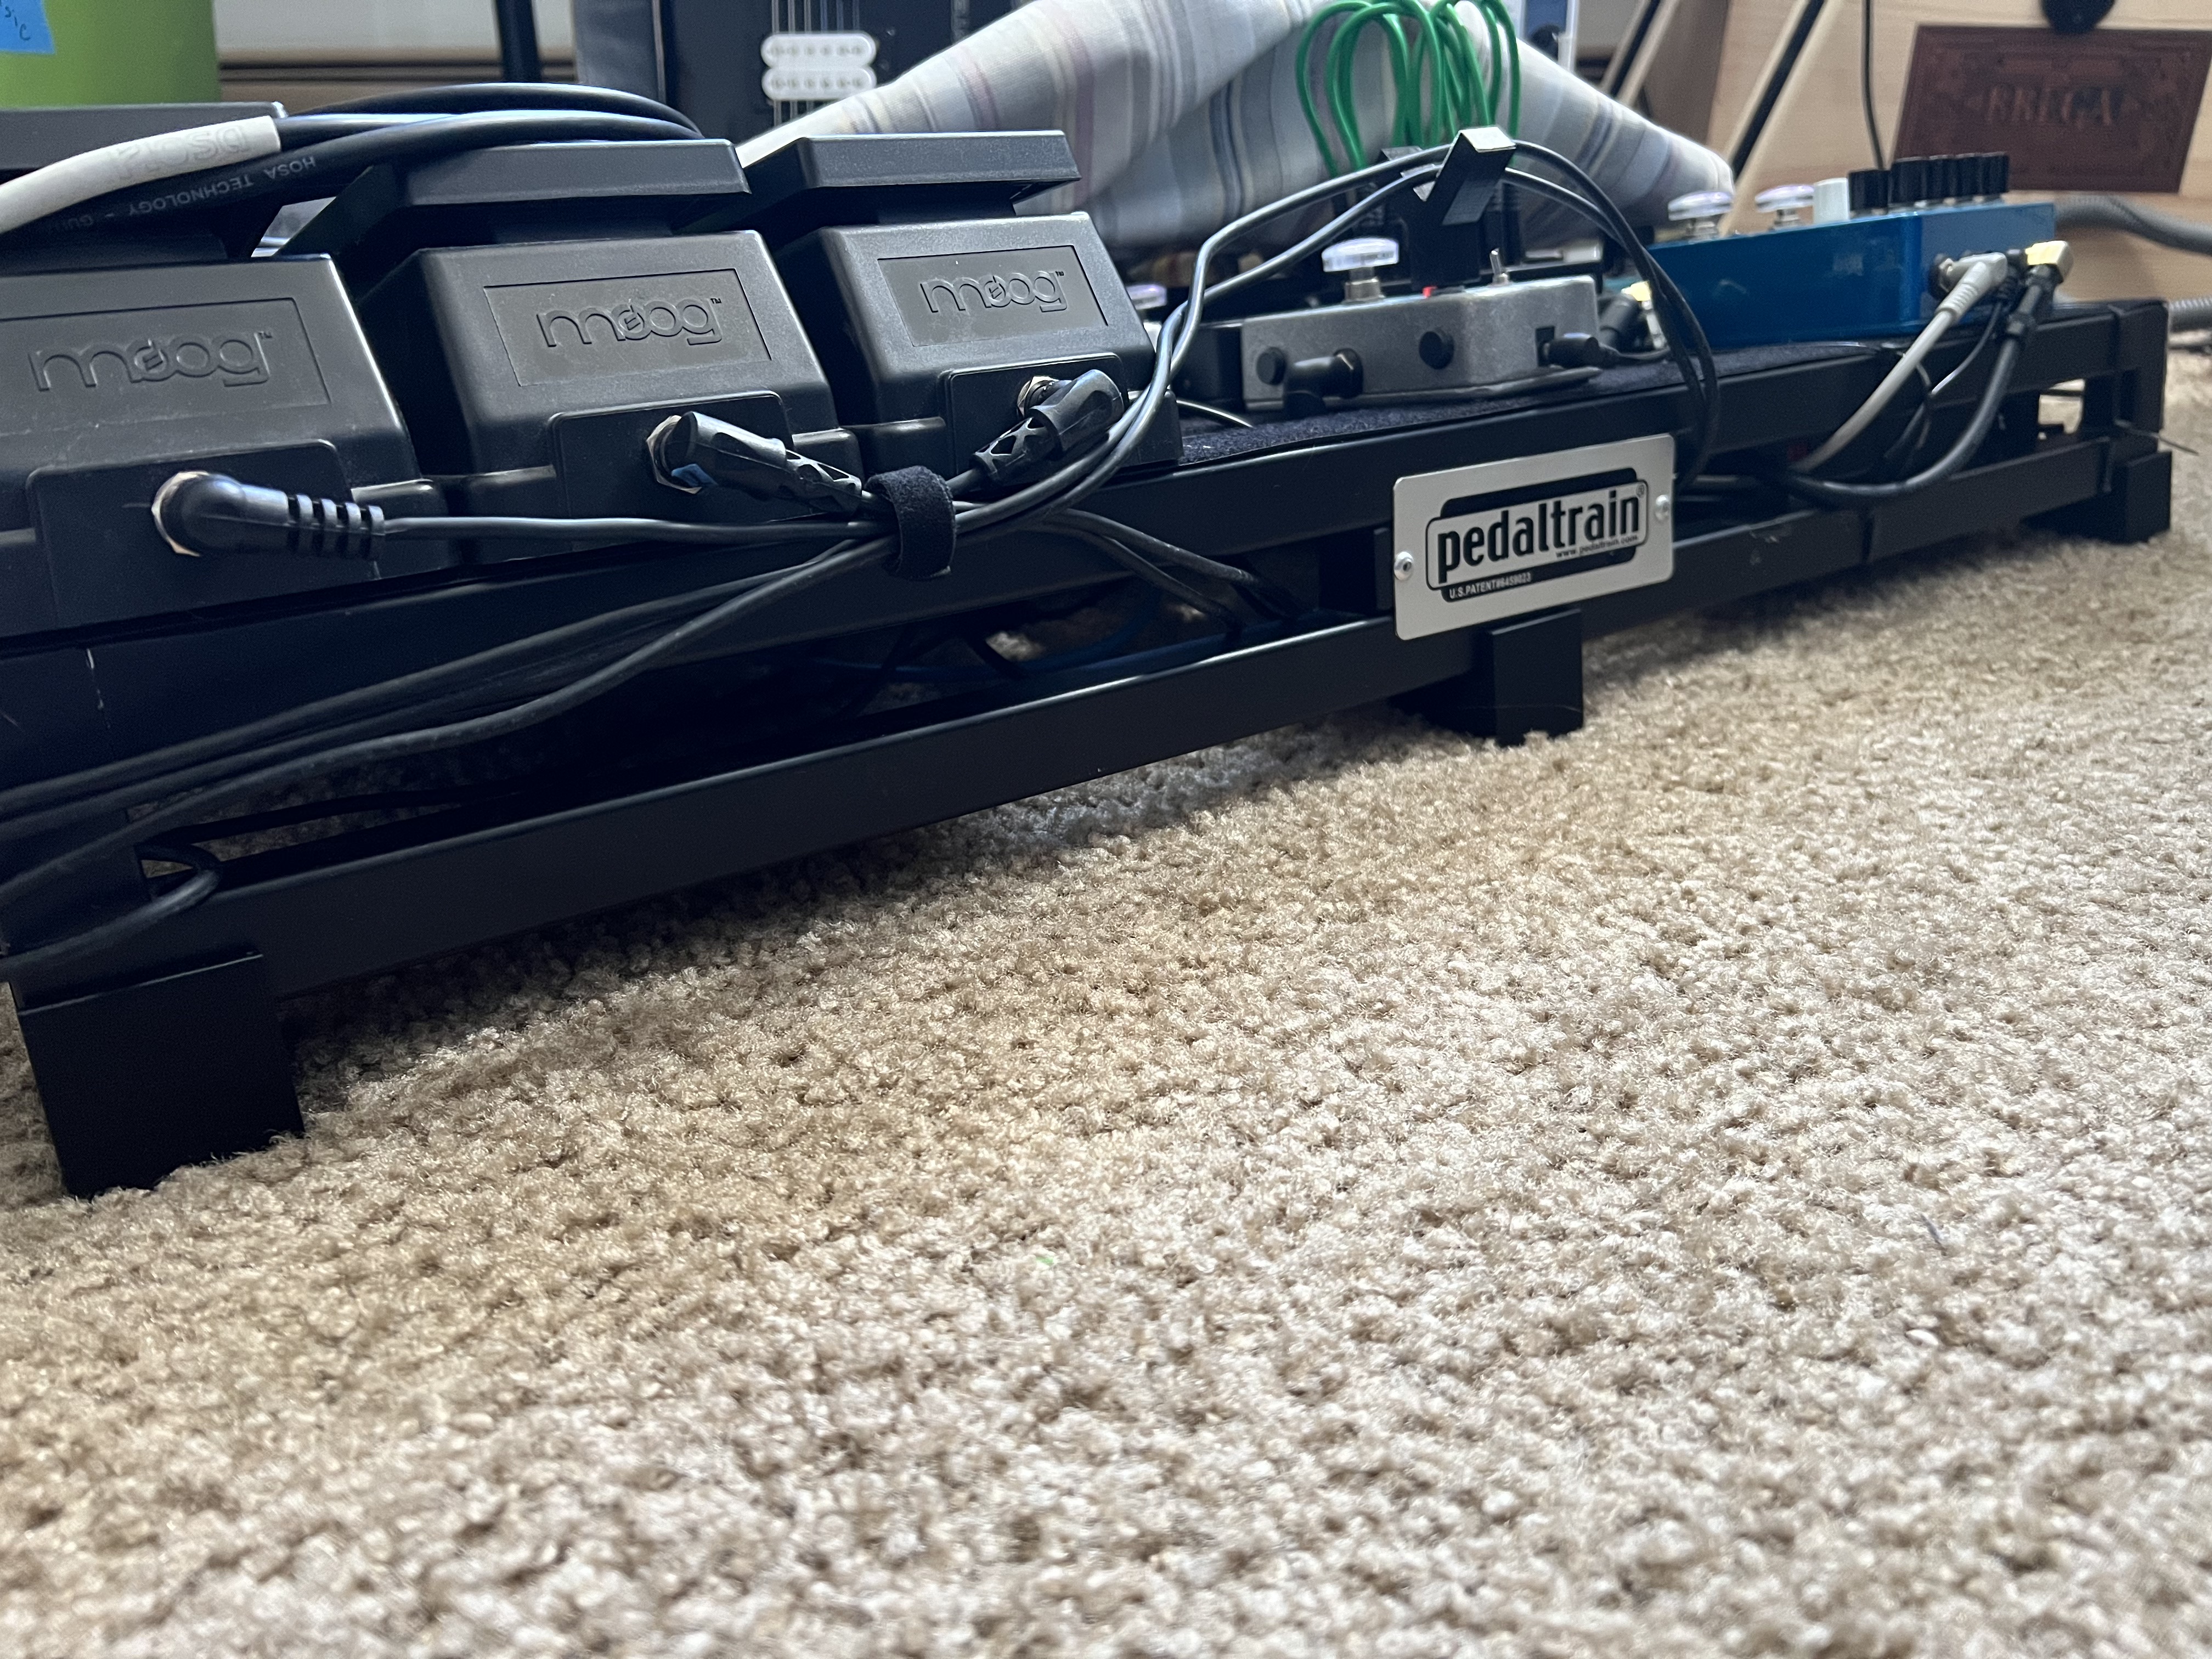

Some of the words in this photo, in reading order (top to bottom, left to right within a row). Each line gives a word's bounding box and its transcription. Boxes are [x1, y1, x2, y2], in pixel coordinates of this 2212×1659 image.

[263, 156, 316, 180] HOSA
[129, 177, 254, 216] TECHNOLOGY
[1437, 489, 1640, 585] pedaltrain
